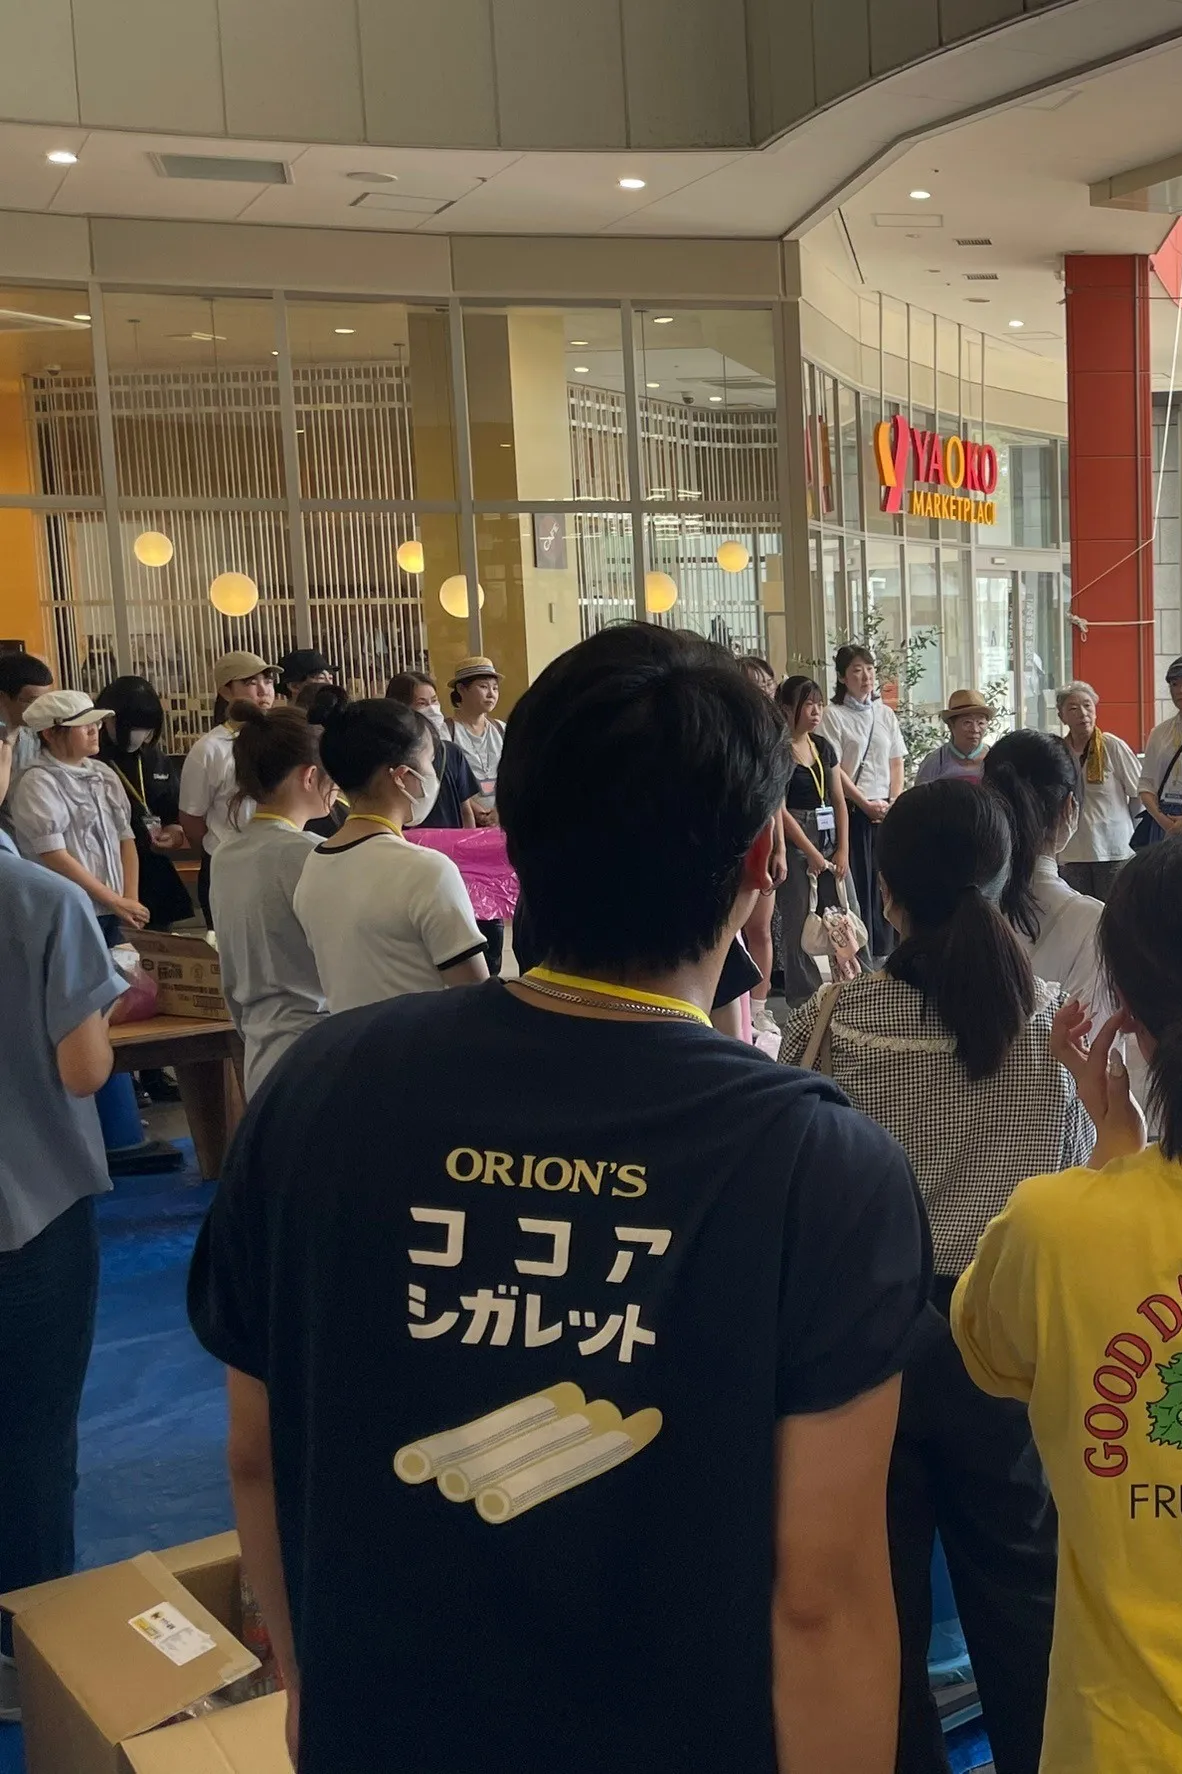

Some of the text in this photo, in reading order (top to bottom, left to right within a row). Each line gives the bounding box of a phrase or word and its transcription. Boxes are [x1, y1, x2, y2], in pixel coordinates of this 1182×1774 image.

[909, 427, 998, 495] YAOKO
[445, 1147, 648, 1198] ORION'S
[407, 1206, 673, 1284] ココア
[407, 1283, 657, 1364] シガレット
[1084, 1332, 1153, 1478] GOOD
